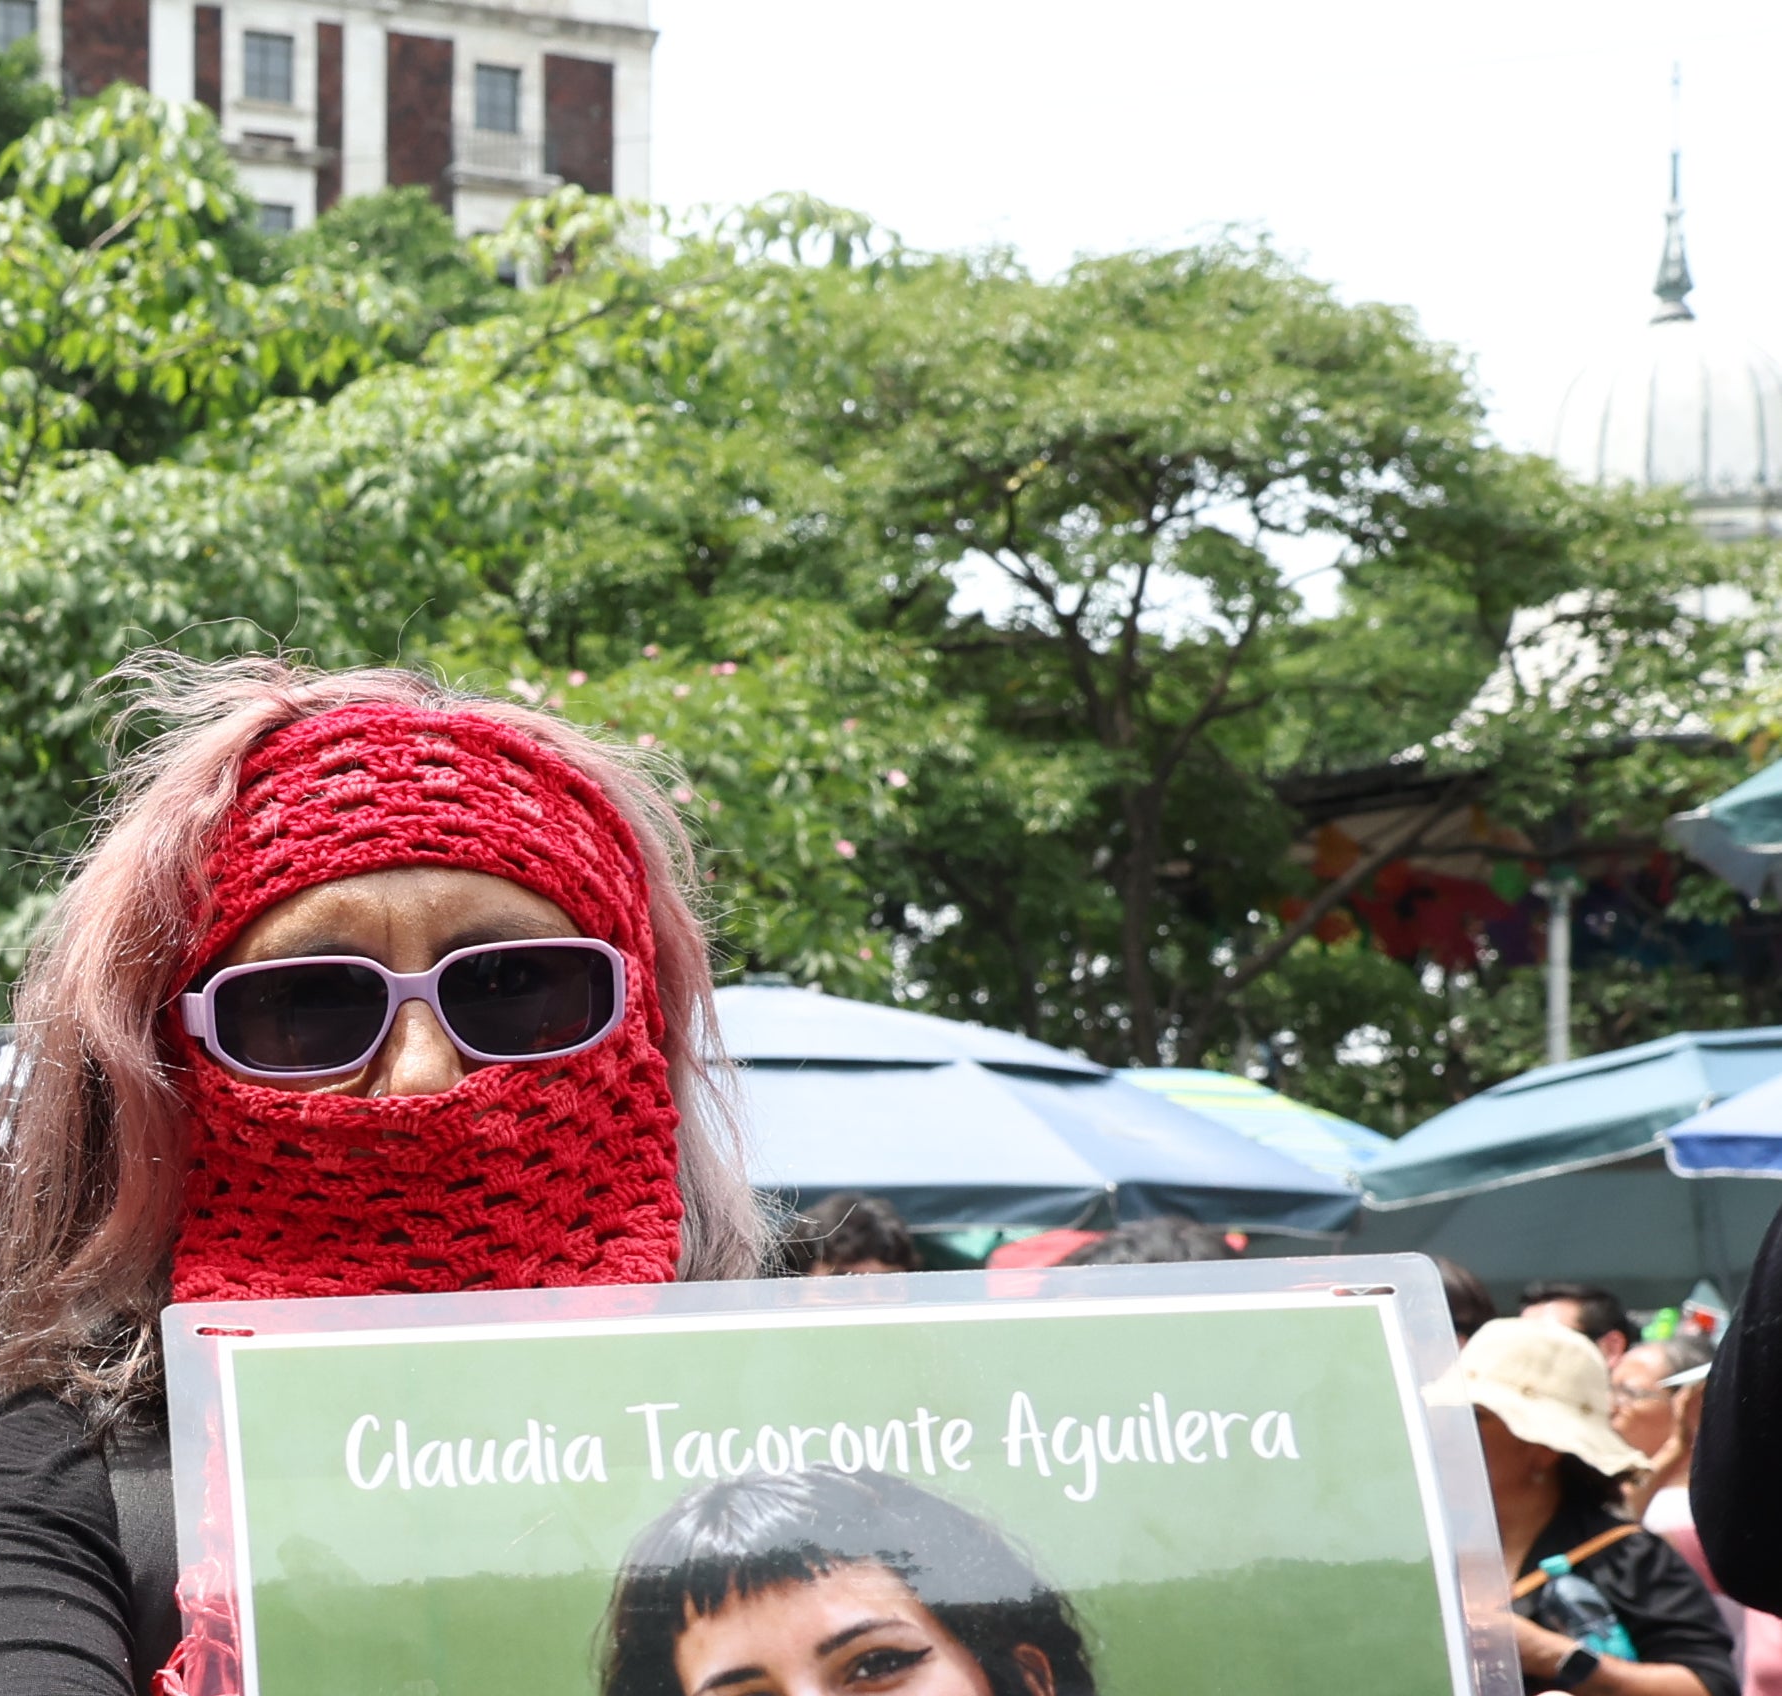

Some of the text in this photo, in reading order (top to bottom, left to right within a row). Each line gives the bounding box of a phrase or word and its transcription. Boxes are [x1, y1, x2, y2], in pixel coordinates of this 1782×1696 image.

[344, 1390, 1301, 1503] Claudia Tacoronte Aguilera
